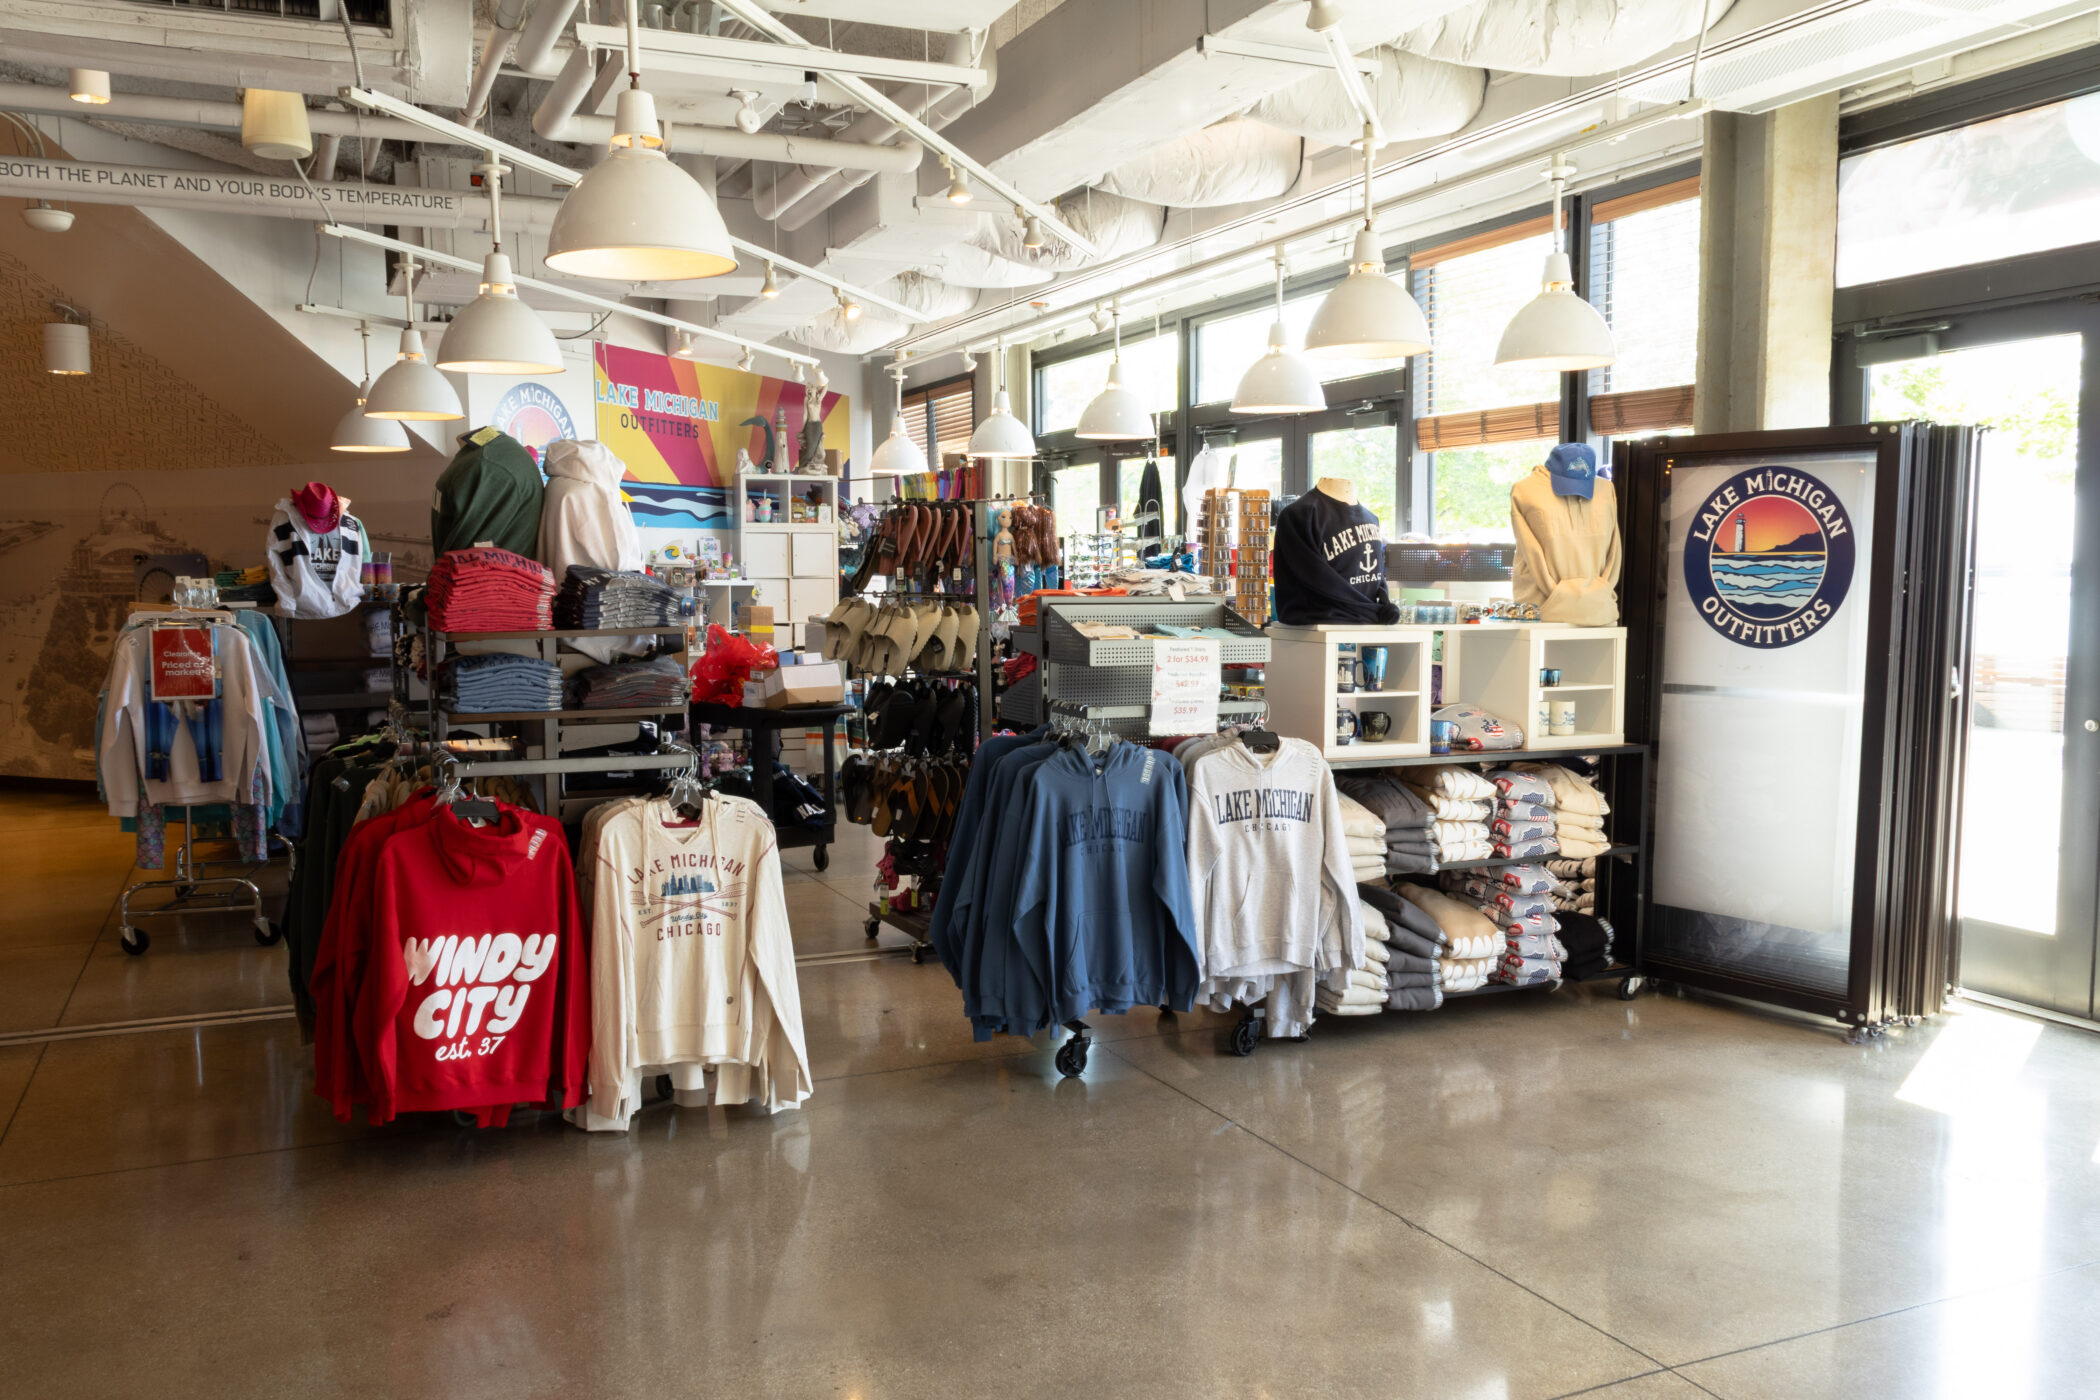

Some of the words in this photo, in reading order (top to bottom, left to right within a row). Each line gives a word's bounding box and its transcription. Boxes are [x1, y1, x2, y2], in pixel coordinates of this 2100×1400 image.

[0, 162, 50, 179] BOTH
[55, 167, 92, 183] THE
[98, 170, 168, 189] PLANET
[174, 176, 211, 193] AND
[216, 179, 264, 196] YOUR
[270, 184, 331, 201] BODY'S
[336, 188, 454, 210] TEMPERATURE
[519, 385, 574, 441] MICHIGAN
[596, 380, 639, 409] LAKE
[644, 388, 719, 422] MICHIGAN
[620, 413, 699, 440] OUTFITTERS
[1693, 485, 1740, 543] LAKE
[1745, 469, 1847, 540] MICHIGAN
[1323, 527, 1358, 562] LAKE
[1702, 595, 1832, 644] OUTFITTERS
[162, 661, 191, 669] Priced
[165, 668, 202, 676] marked
[1167, 655, 1172, 664] 2
[1173, 655, 1183, 663] for
[1185, 655, 1209, 664] $34.99
[1088, 804, 1148, 845] MICHIGAN
[1215, 789, 1250, 825] LAKE
[1255, 788, 1315, 824] MICHIGAN
[638, 908, 653, 916] EST.
[656, 922, 721, 942] CHICAGO
[403, 932, 557, 988] WINDY
[413, 984, 531, 1040] CITY
[435, 1036, 472, 1062] est.
[478, 1035, 506, 1056] 37
